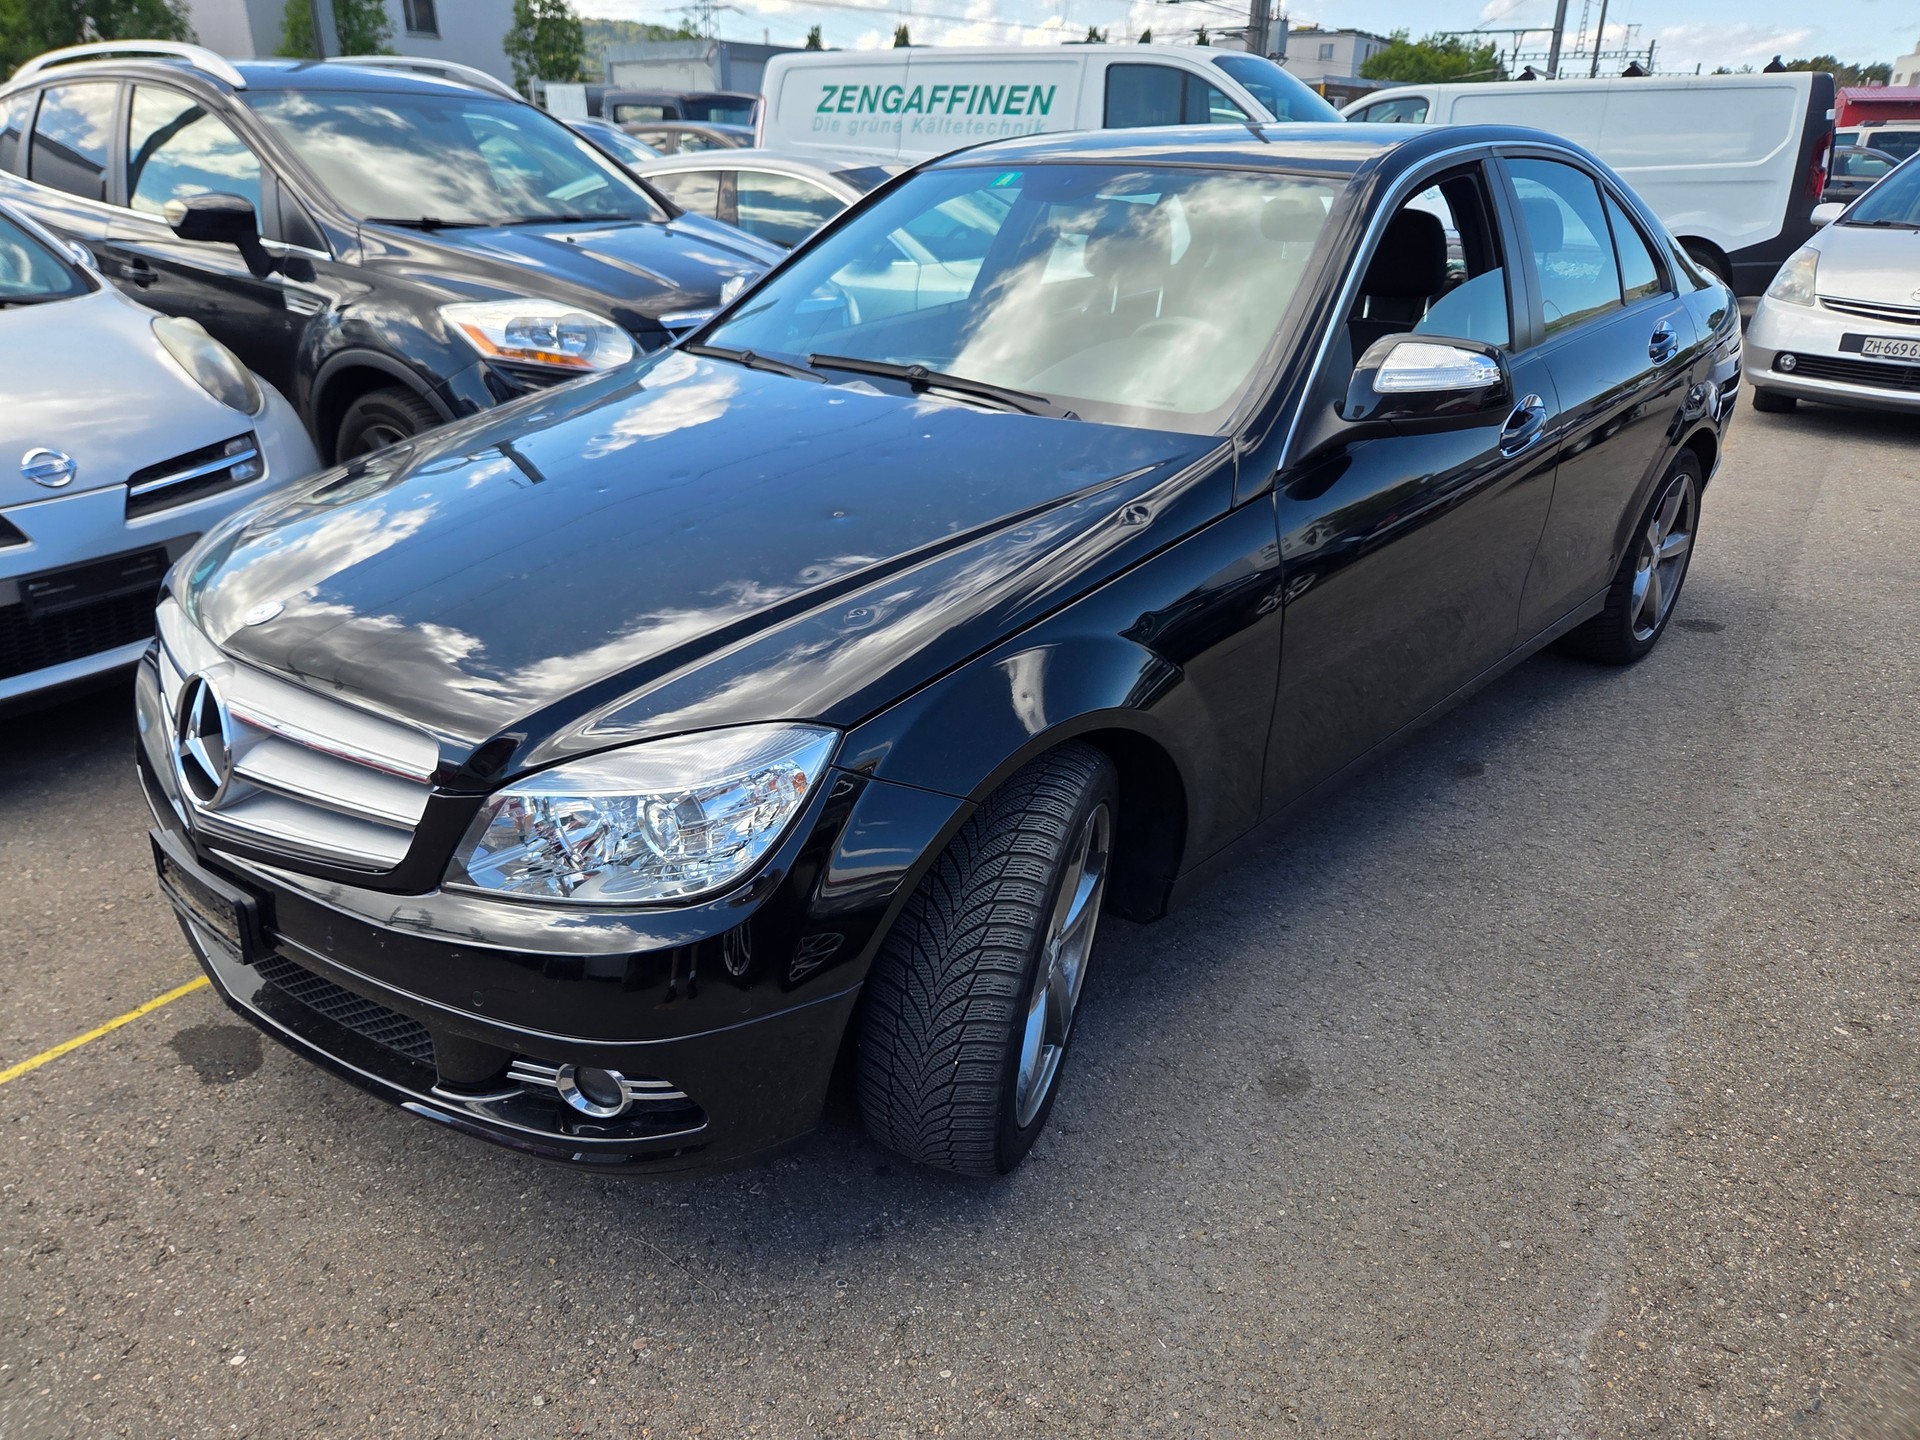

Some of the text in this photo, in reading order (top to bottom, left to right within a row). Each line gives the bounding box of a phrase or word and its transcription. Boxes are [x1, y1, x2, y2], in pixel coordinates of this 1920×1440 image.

[816, 85, 1057, 115] ZENGAFFINEN
[812, 116, 1045, 137] Die grüne Kältetechnik
[1910, 344, 1920, 357] 6
